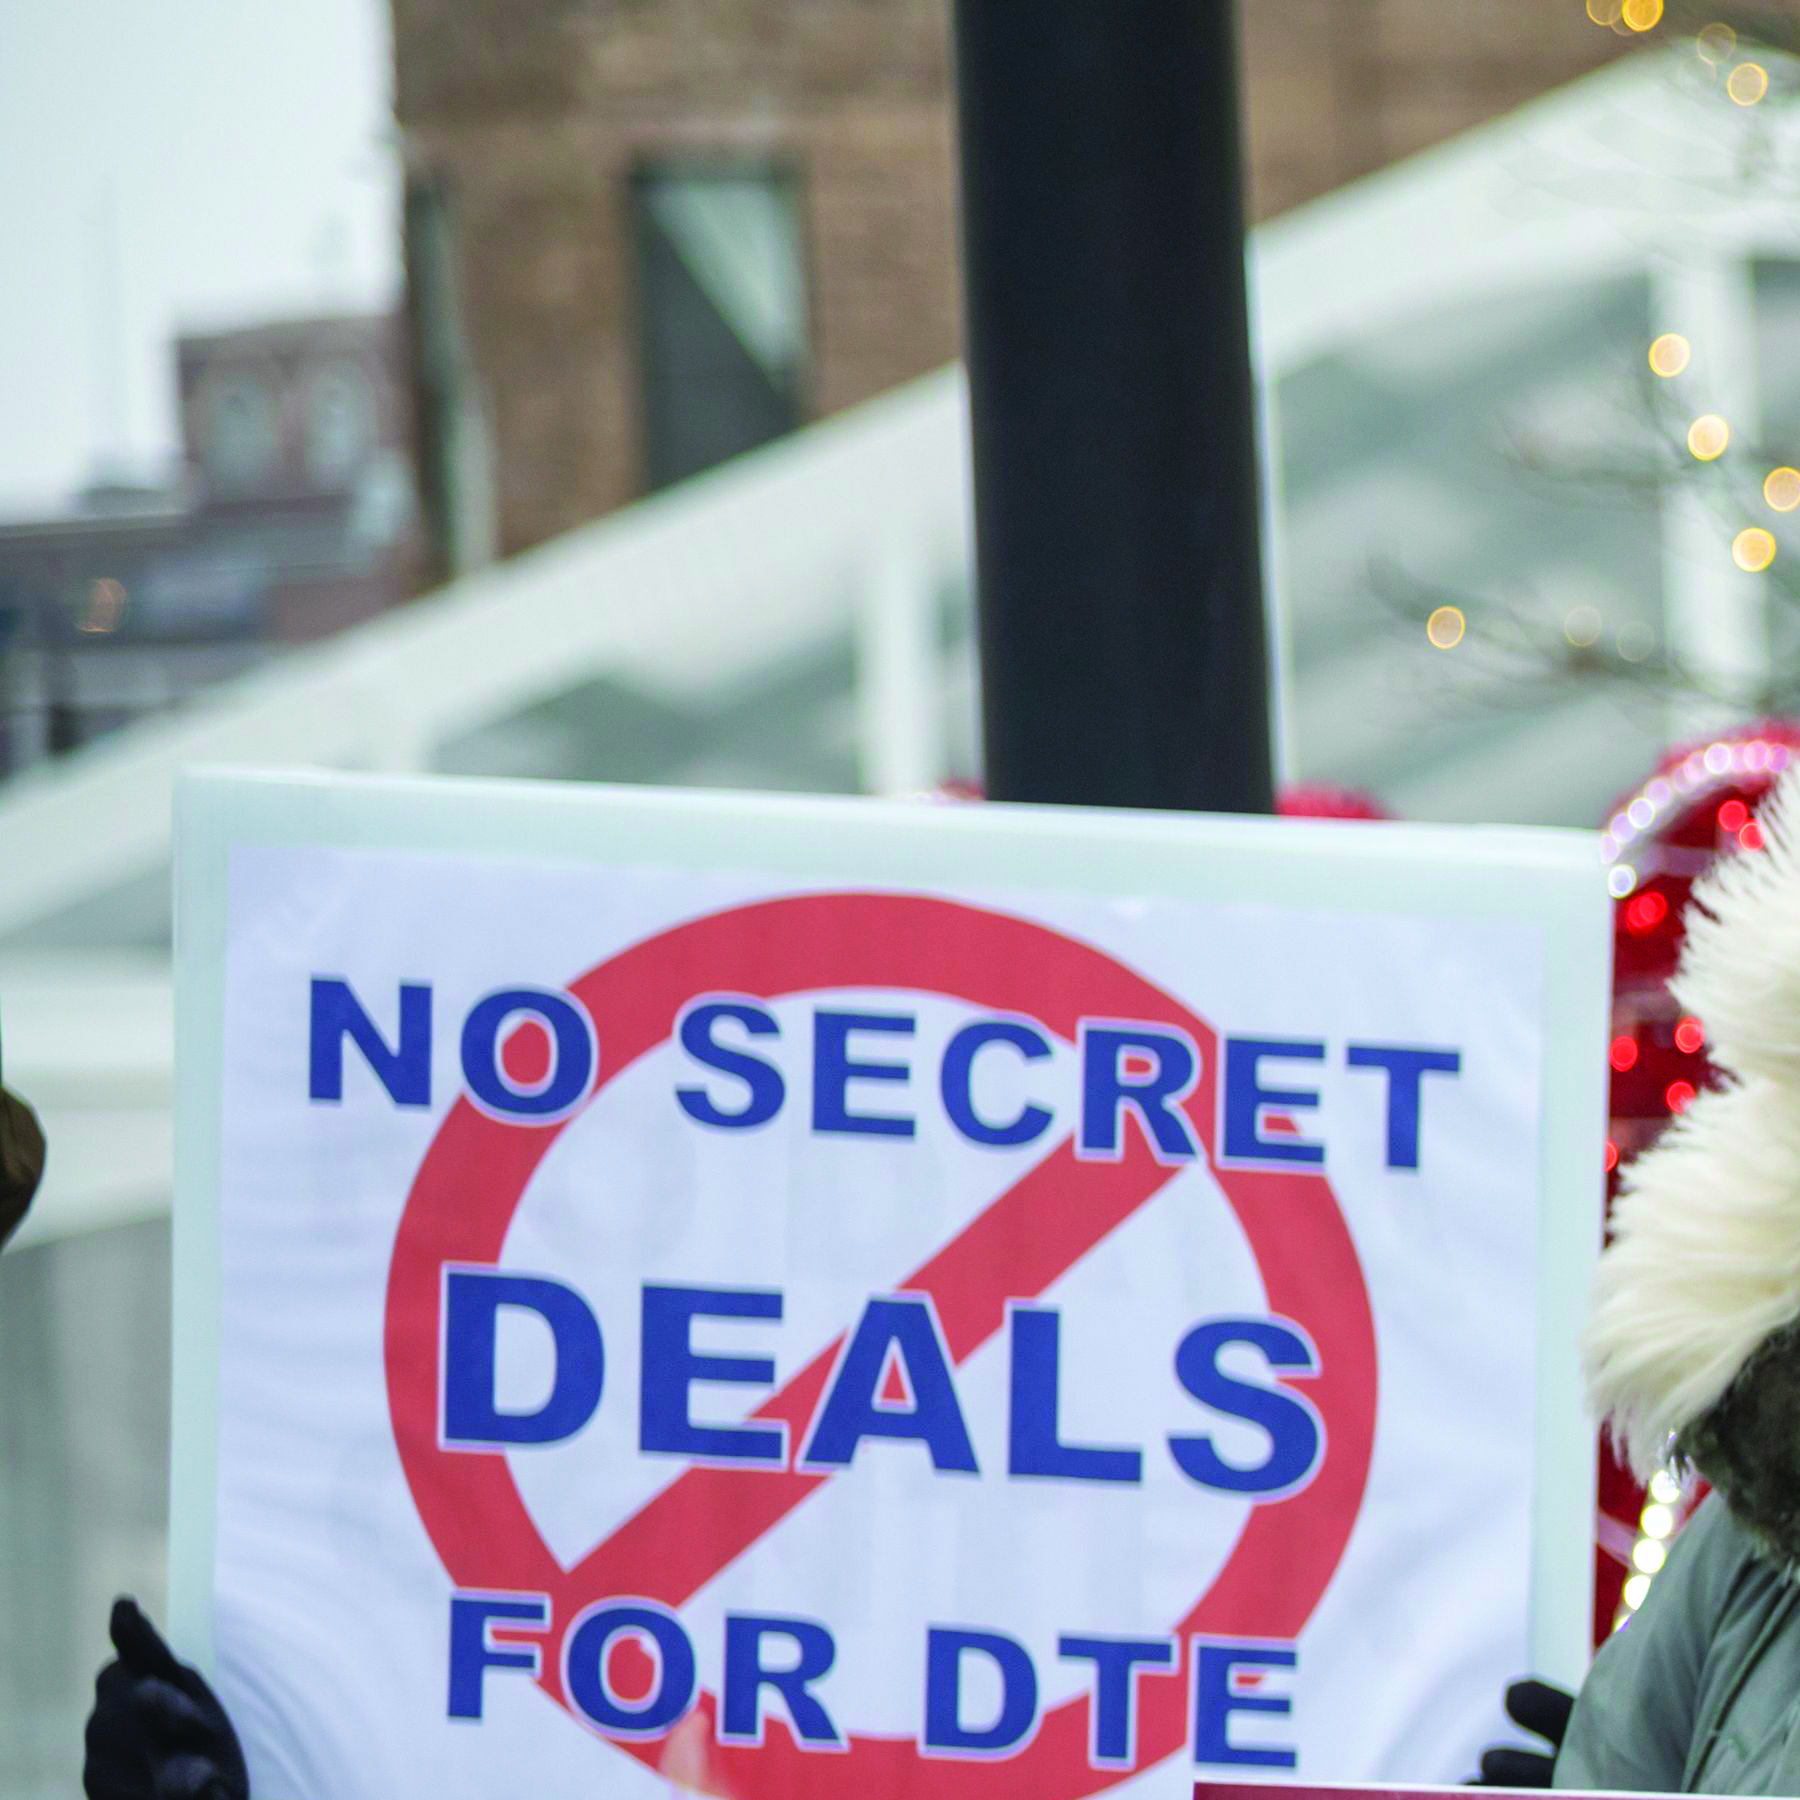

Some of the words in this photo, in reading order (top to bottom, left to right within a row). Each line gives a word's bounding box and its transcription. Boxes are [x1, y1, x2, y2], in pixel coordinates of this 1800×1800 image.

[308, 976, 594, 1118] NO
[674, 1001, 1461, 1170] SECRET
[443, 1270, 1321, 1495] DEALS
[446, 1596, 842, 1746] FOR
[924, 1626, 1298, 1770] DTE
